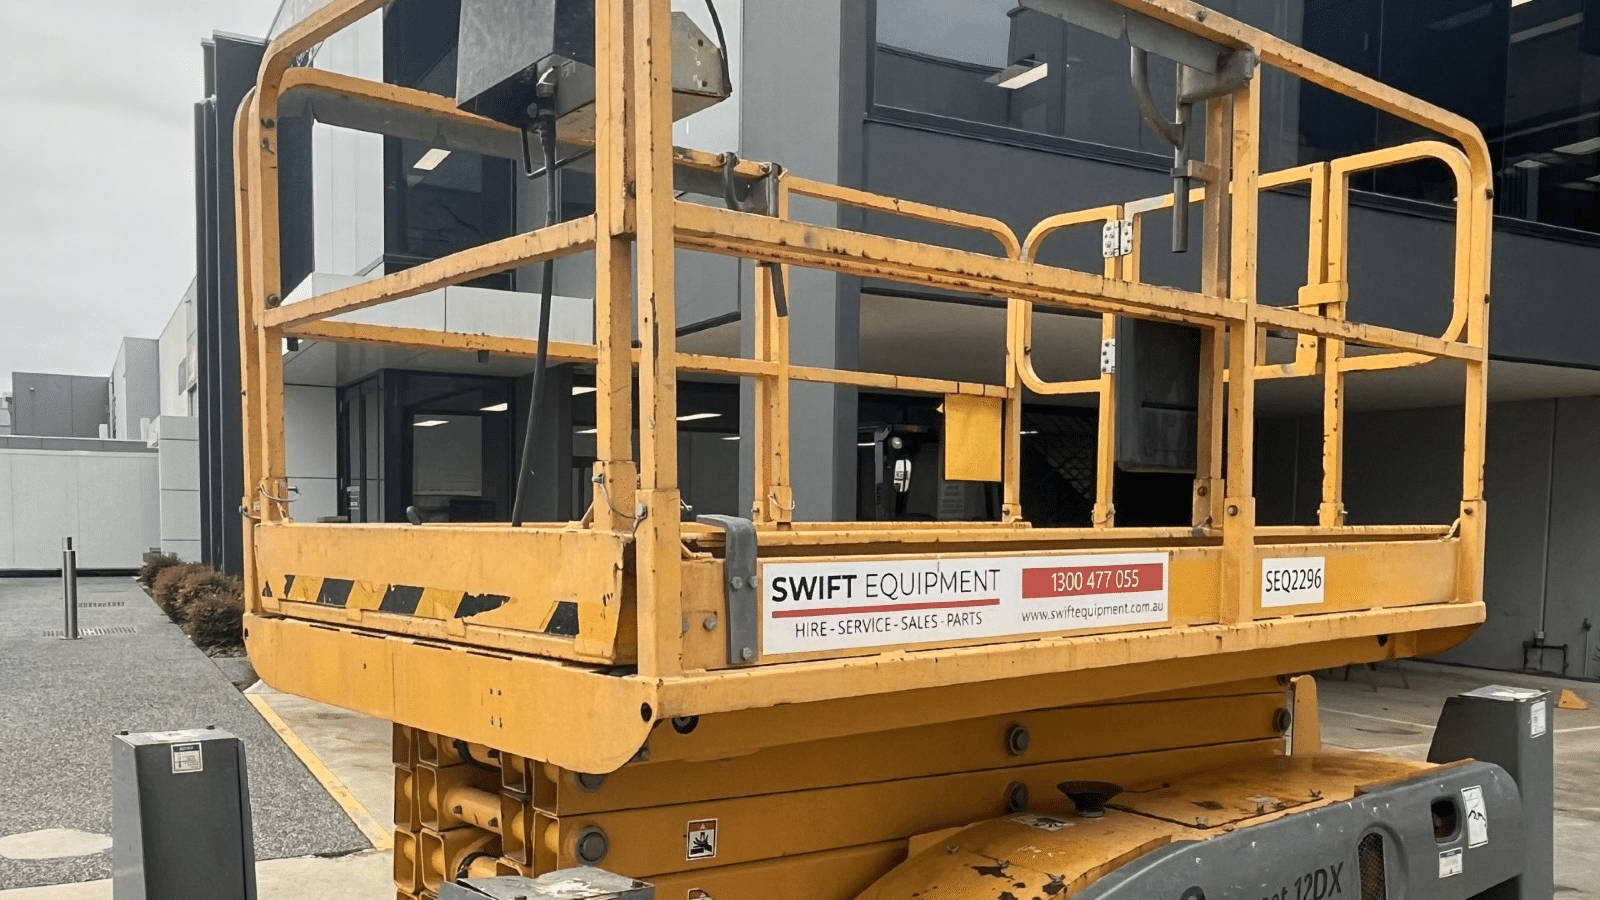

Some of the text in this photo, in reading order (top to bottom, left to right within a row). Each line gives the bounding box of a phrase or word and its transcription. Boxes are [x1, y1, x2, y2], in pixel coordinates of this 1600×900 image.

[771, 569, 1000, 602] SWIFT EQUIPMENT
[1050, 569, 1140, 592] 1300 477 055
[1265, 568, 1322, 593] SEQ2296
[1021, 602, 1164, 622] www.swiftequipment.com.au
[1294, 861, 1344, 900] 12DX
